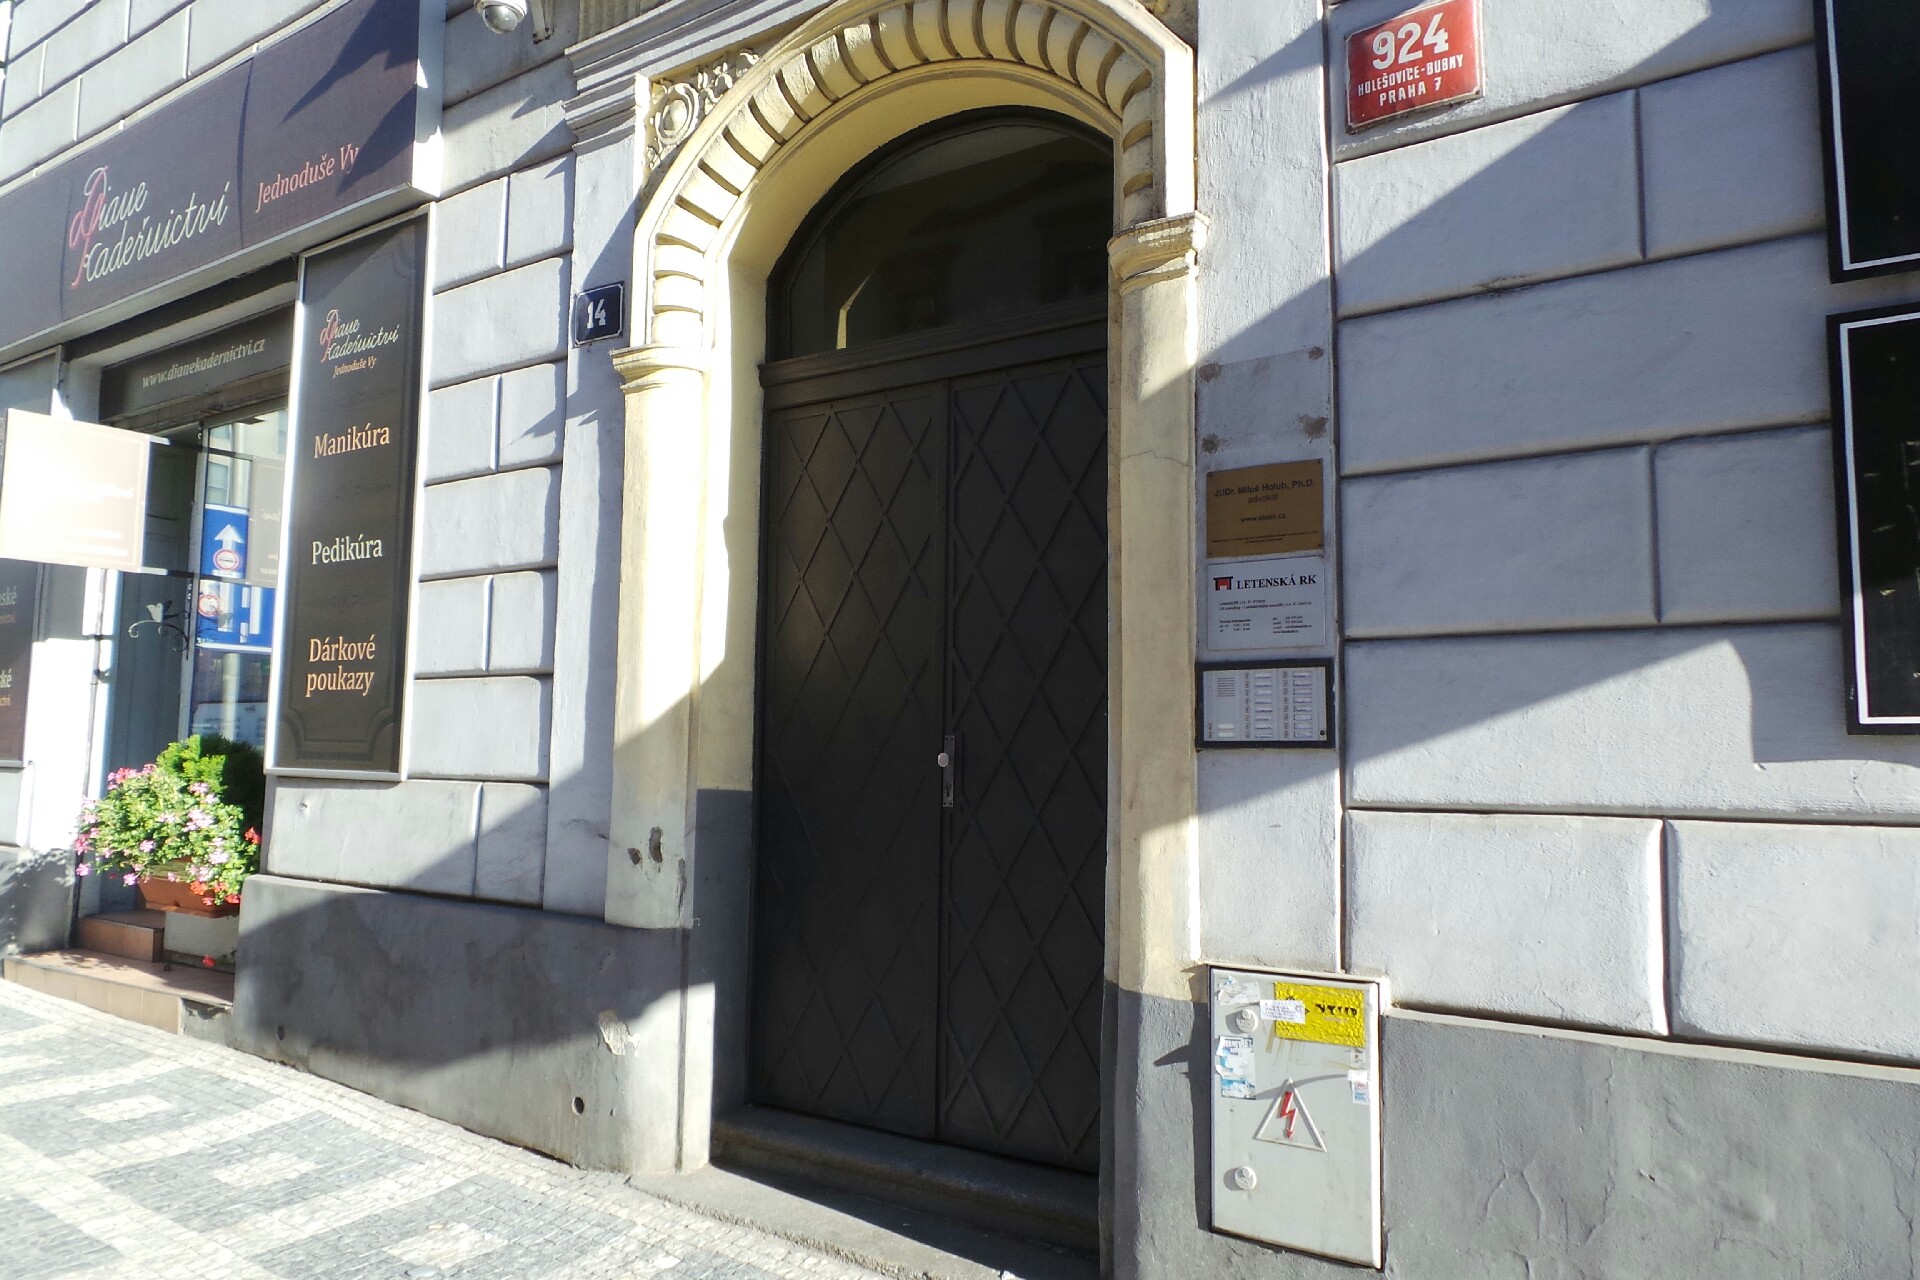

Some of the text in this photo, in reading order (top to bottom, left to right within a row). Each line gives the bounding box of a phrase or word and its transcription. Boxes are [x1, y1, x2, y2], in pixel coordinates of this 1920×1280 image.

[1372, 12, 1449, 70] 924
[1358, 54, 1464, 96] HOLEŠOVICE-BUBNY
[1379, 76, 1442, 106] PRAHA 7
[255, 143, 359, 213] Jednoduše Vy
[69, 165, 149, 249] Diane
[71, 181, 231, 289] Kadeřnictví
[320, 309, 360, 346] Diane
[586, 298, 606, 329] 14
[142, 339, 266, 389] www.dianekadernictvi.cz
[332, 358, 367, 379] Jednoduše
[313, 422, 390, 459] Manikúra
[1214, 488, 1236, 498] JUDr.
[1238, 484, 1259, 495] Miloš
[1262, 481, 1290, 492] Holub,
[311, 533, 383, 565] Pedikúra
[1236, 574, 1317, 590] LETENSKÁ RK
[308, 633, 376, 662] Dárkové
[304, 664, 376, 698] poukazy
